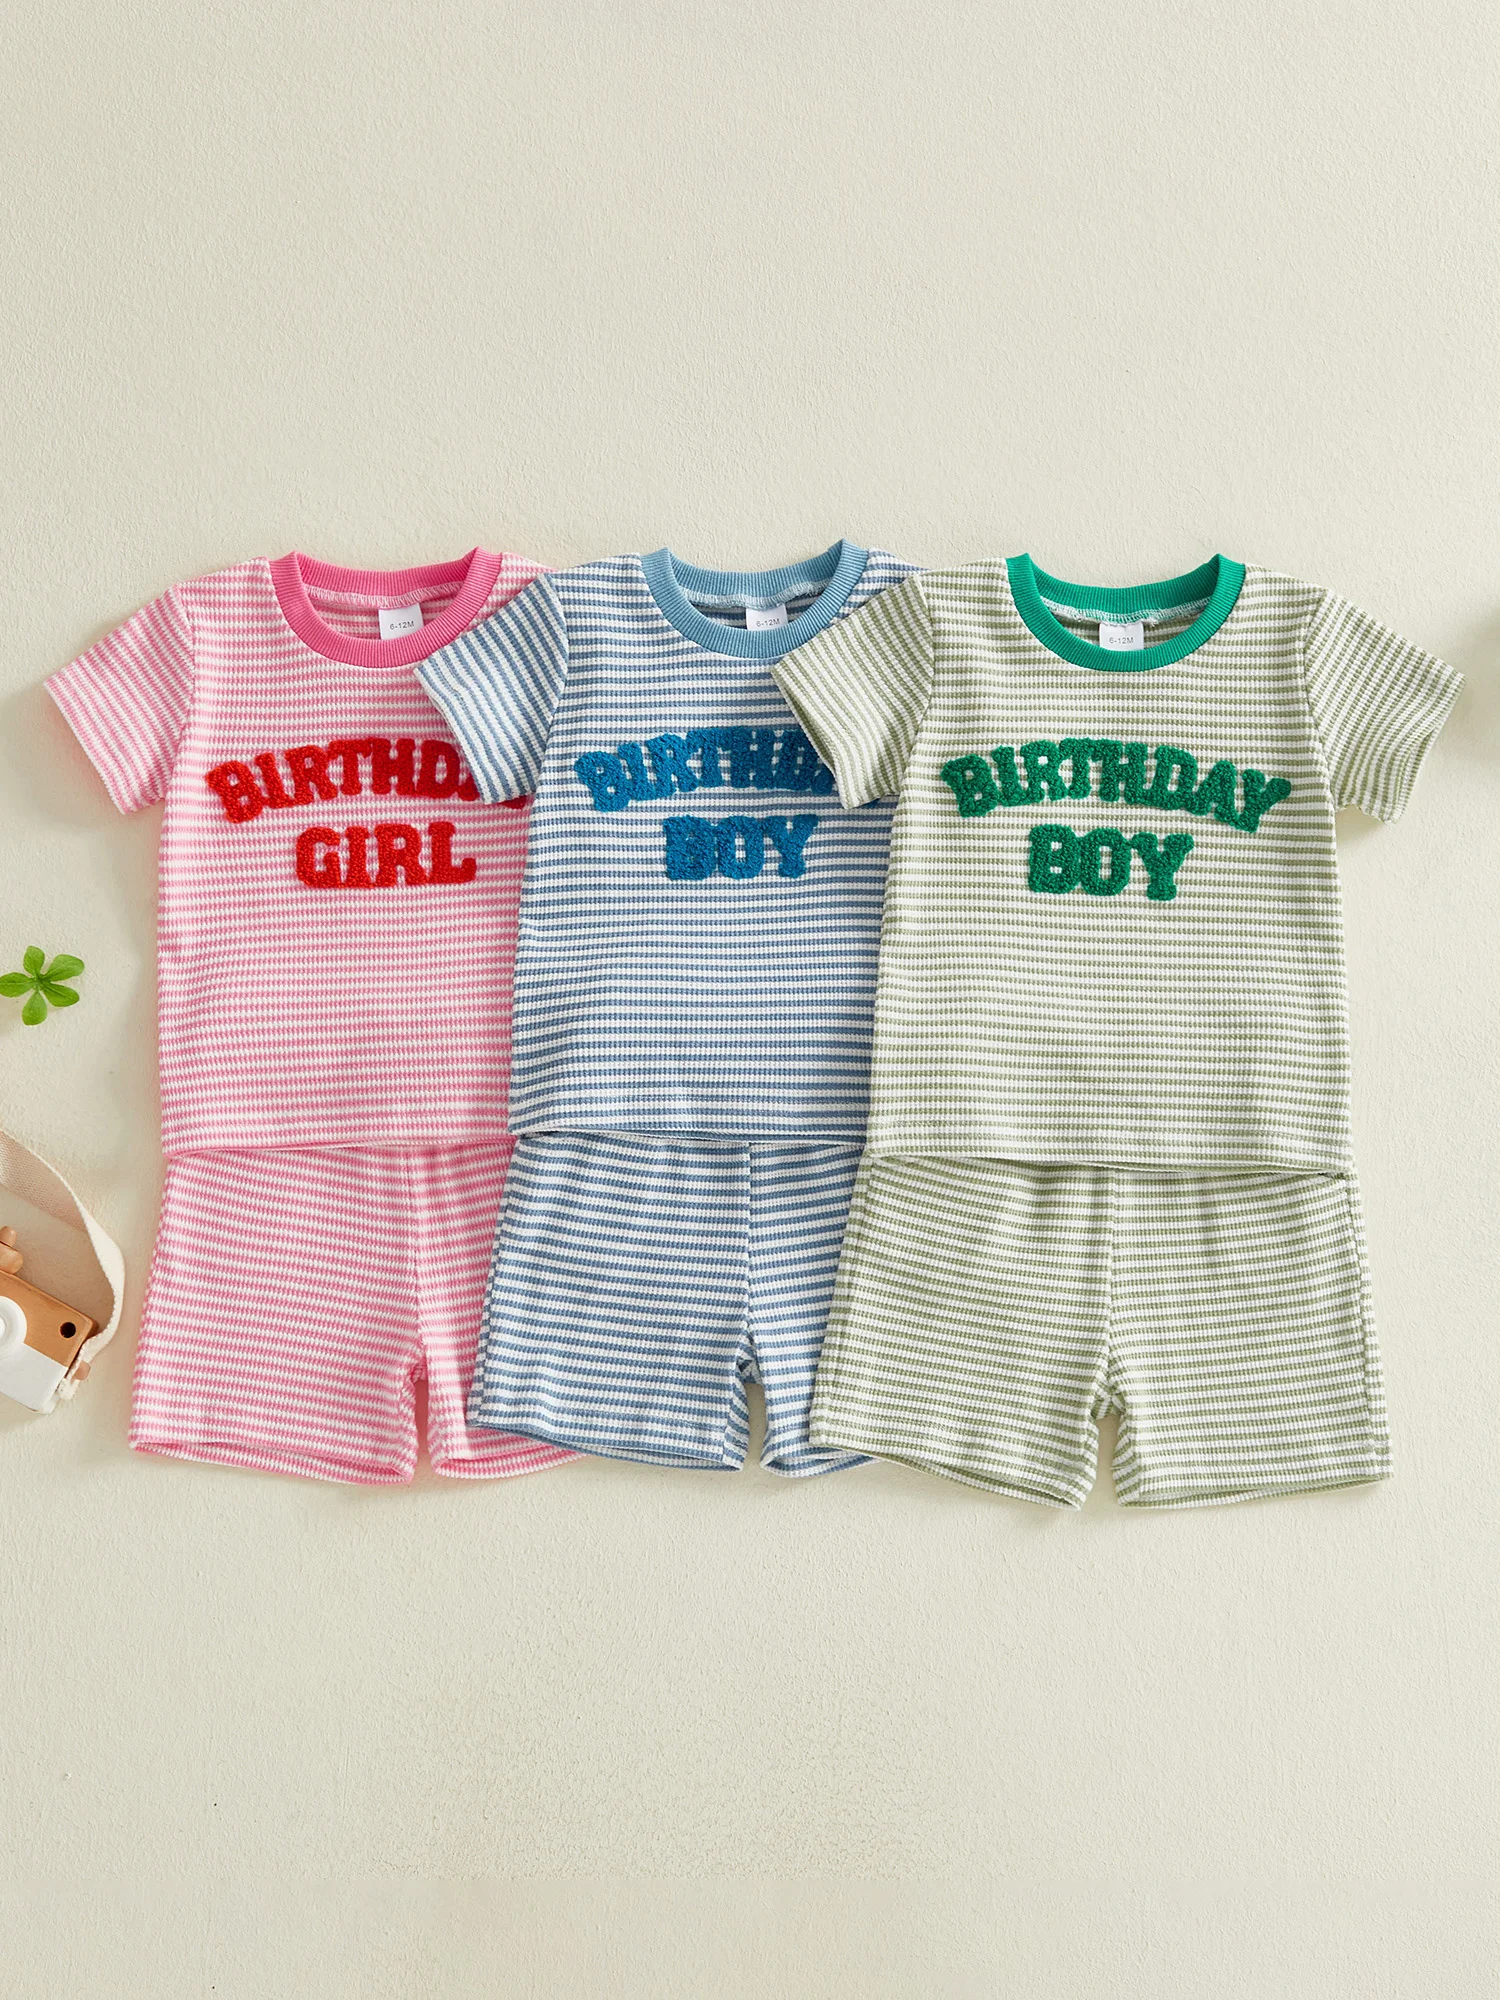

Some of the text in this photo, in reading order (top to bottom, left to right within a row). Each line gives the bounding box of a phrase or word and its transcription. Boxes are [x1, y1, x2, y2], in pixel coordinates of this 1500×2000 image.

[389, 620, 415, 630] 6-12M
[756, 618, 780, 627] 6-12M
[1109, 636, 1134, 645] 6-12M
[204, 737, 526, 823] BIRTHD
[573, 726, 878, 812] BIRTHD
[940, 738, 1291, 833] BIRTHDAY
[296, 821, 477, 888] GIRL
[663, 814, 819, 880] BOY
[1028, 824, 1194, 900] BOY
